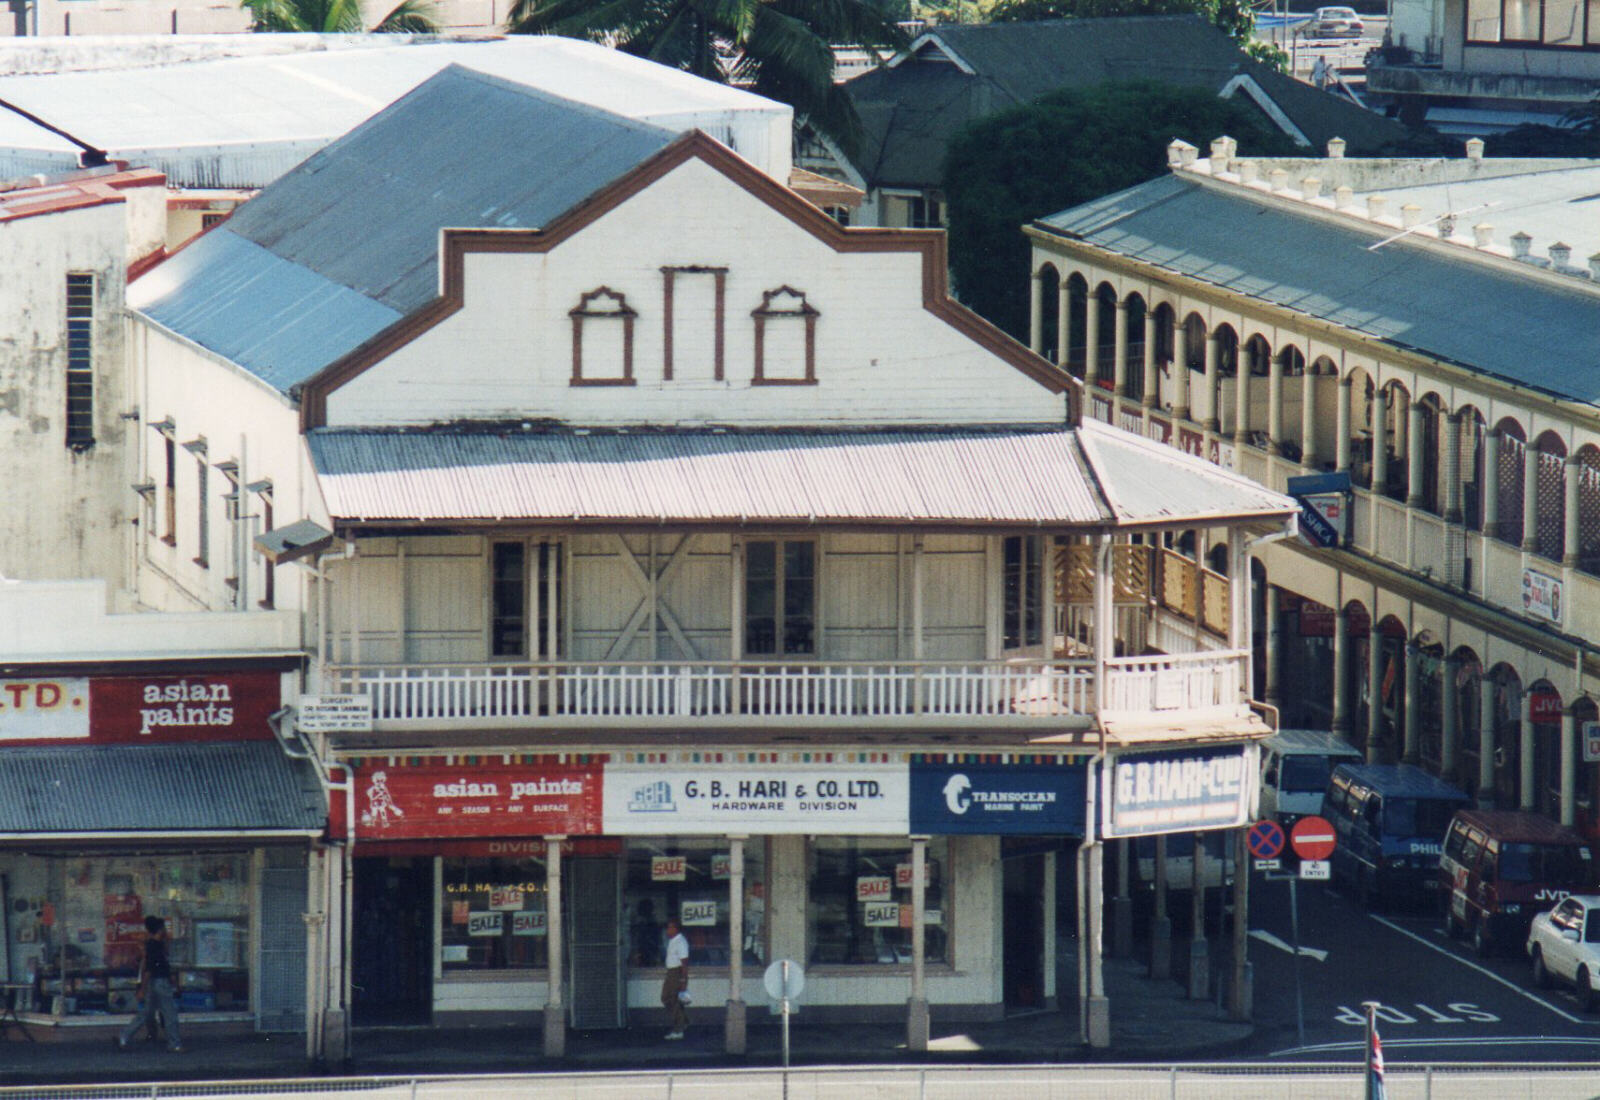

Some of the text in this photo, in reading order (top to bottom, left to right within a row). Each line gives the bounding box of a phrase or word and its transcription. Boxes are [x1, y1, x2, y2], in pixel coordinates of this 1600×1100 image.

[1303, 507, 1333, 543] ASHICA
[0, 684, 81, 708] TD.
[144, 679, 231, 703] asian
[140, 702, 234, 734] paints
[433, 777, 583, 799] asian paints
[738, 781, 786, 798] HARI
[795, 785, 807, 798] &
[972, 792, 1056, 802] TRANSOCEAN
[462, 806, 490, 814] SEASON
[508, 805, 523, 813] ANY
[533, 804, 568, 812] SURFACE
[712, 801, 857, 811] HARDWARE DIVISION
[984, 803, 1043, 811] MARINE PAINT
[489, 842, 574, 853] DIVISIN
[1410, 843, 1442, 854] PHIL
[654, 860, 684, 877] SALE
[712, 861, 731, 875] SA
[859, 880, 889, 897] SALE
[490, 891, 521, 907] SALE
[684, 905, 714, 921] SALE
[867, 906, 897, 923] SALE
[470, 916, 501, 932] SALE
[514, 916, 545, 931] SALE
[1334, 1002, 1500, 1025] STOP
